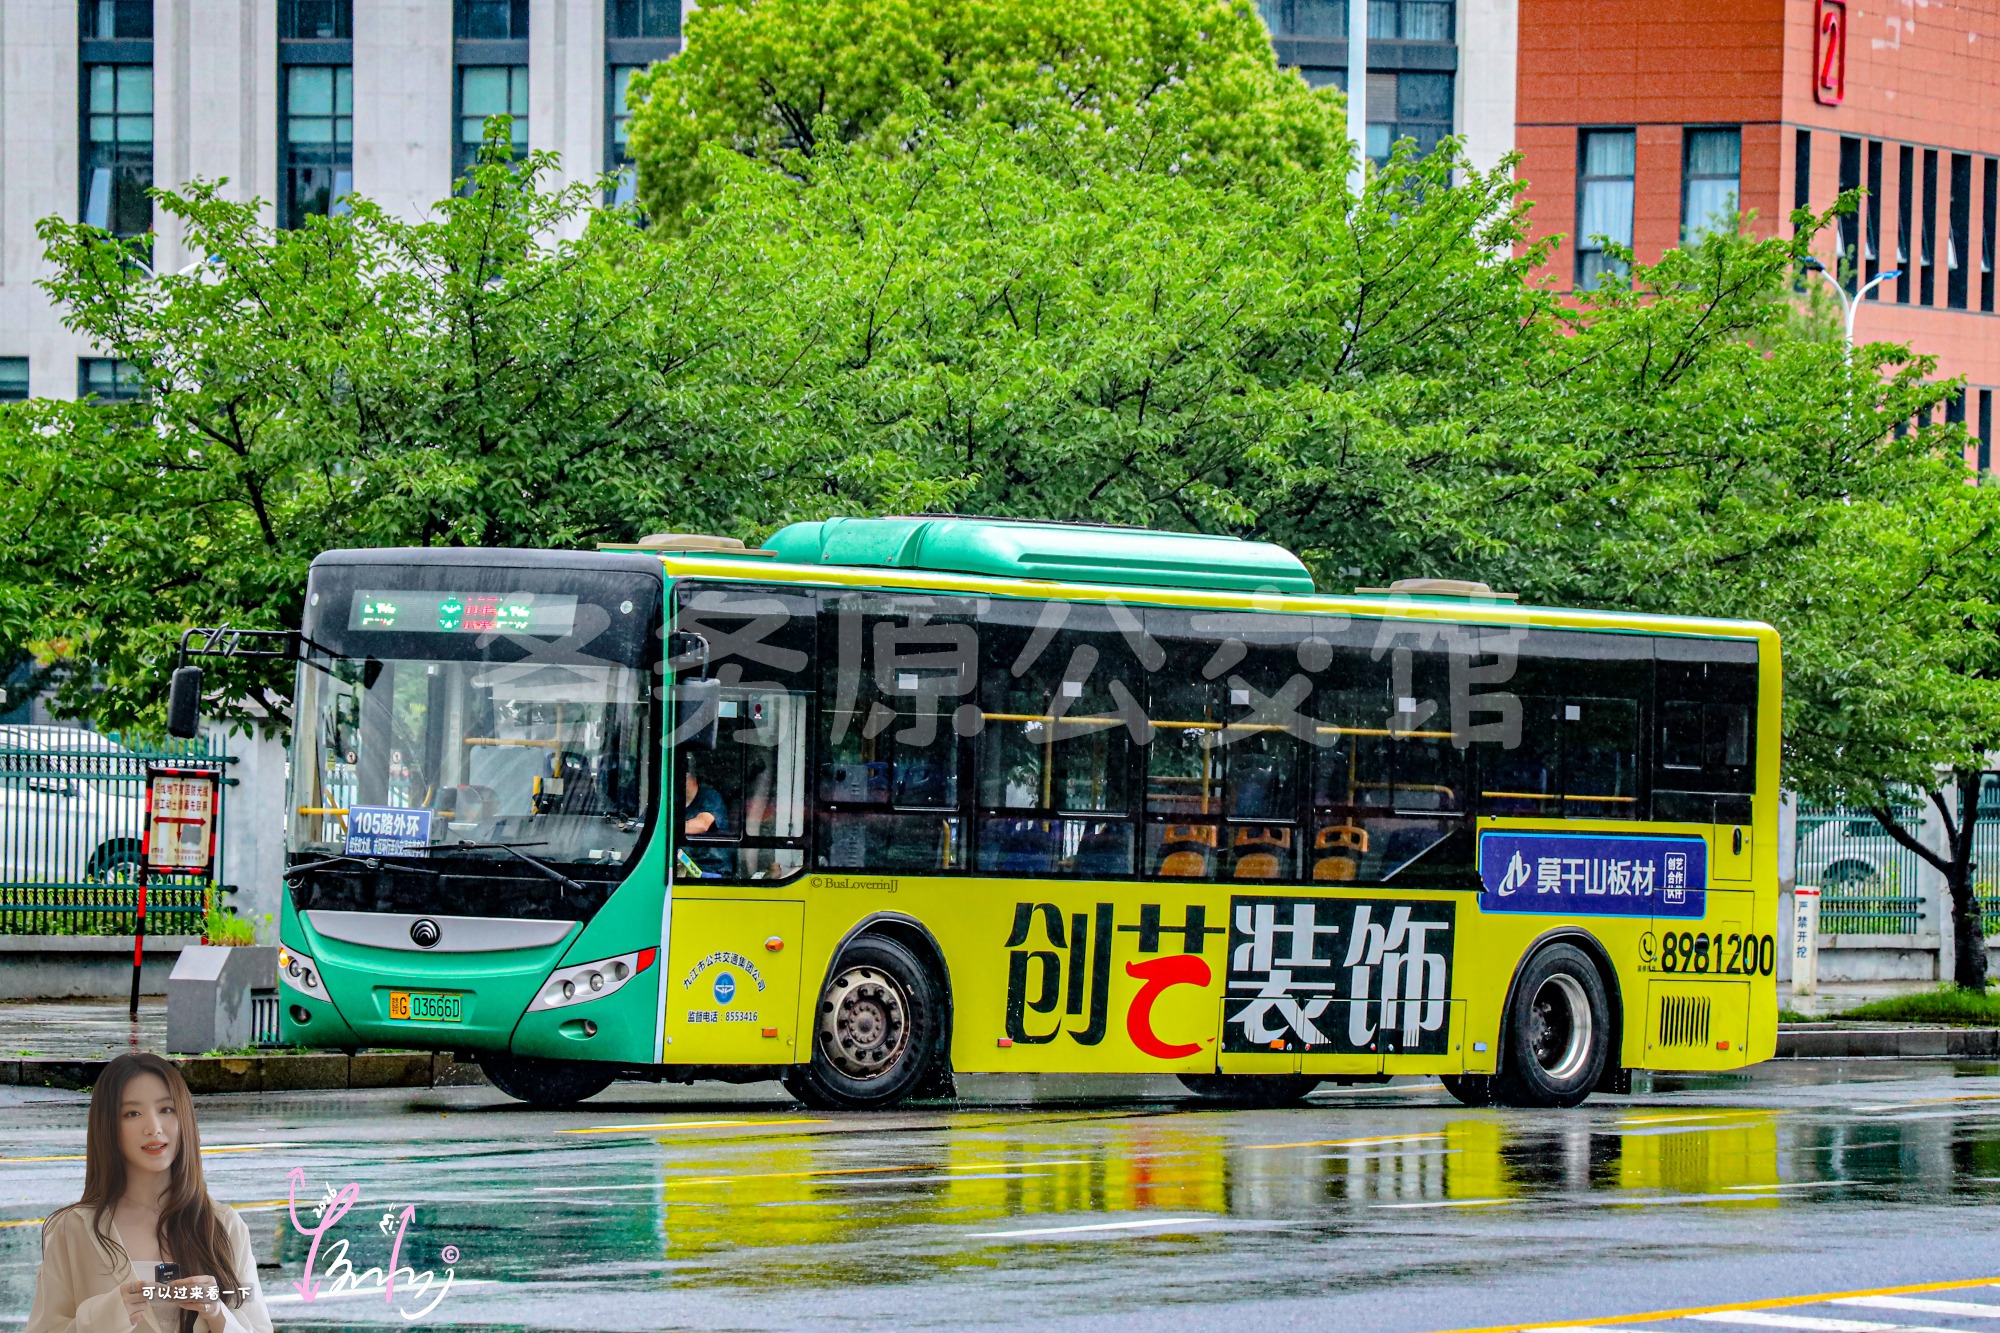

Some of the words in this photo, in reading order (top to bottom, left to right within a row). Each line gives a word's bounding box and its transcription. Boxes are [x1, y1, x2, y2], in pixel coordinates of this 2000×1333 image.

[1820, 12, 1839, 90] 2
[355, 812, 420, 837] 105路外环
[1537, 857, 1656, 896] 莫干山板材
[1796, 900, 1809, 959] 严禁开挖
[683, 952, 766, 992] 九江市公共交通集团公司
[1661, 931, 1775, 976] 8981200
